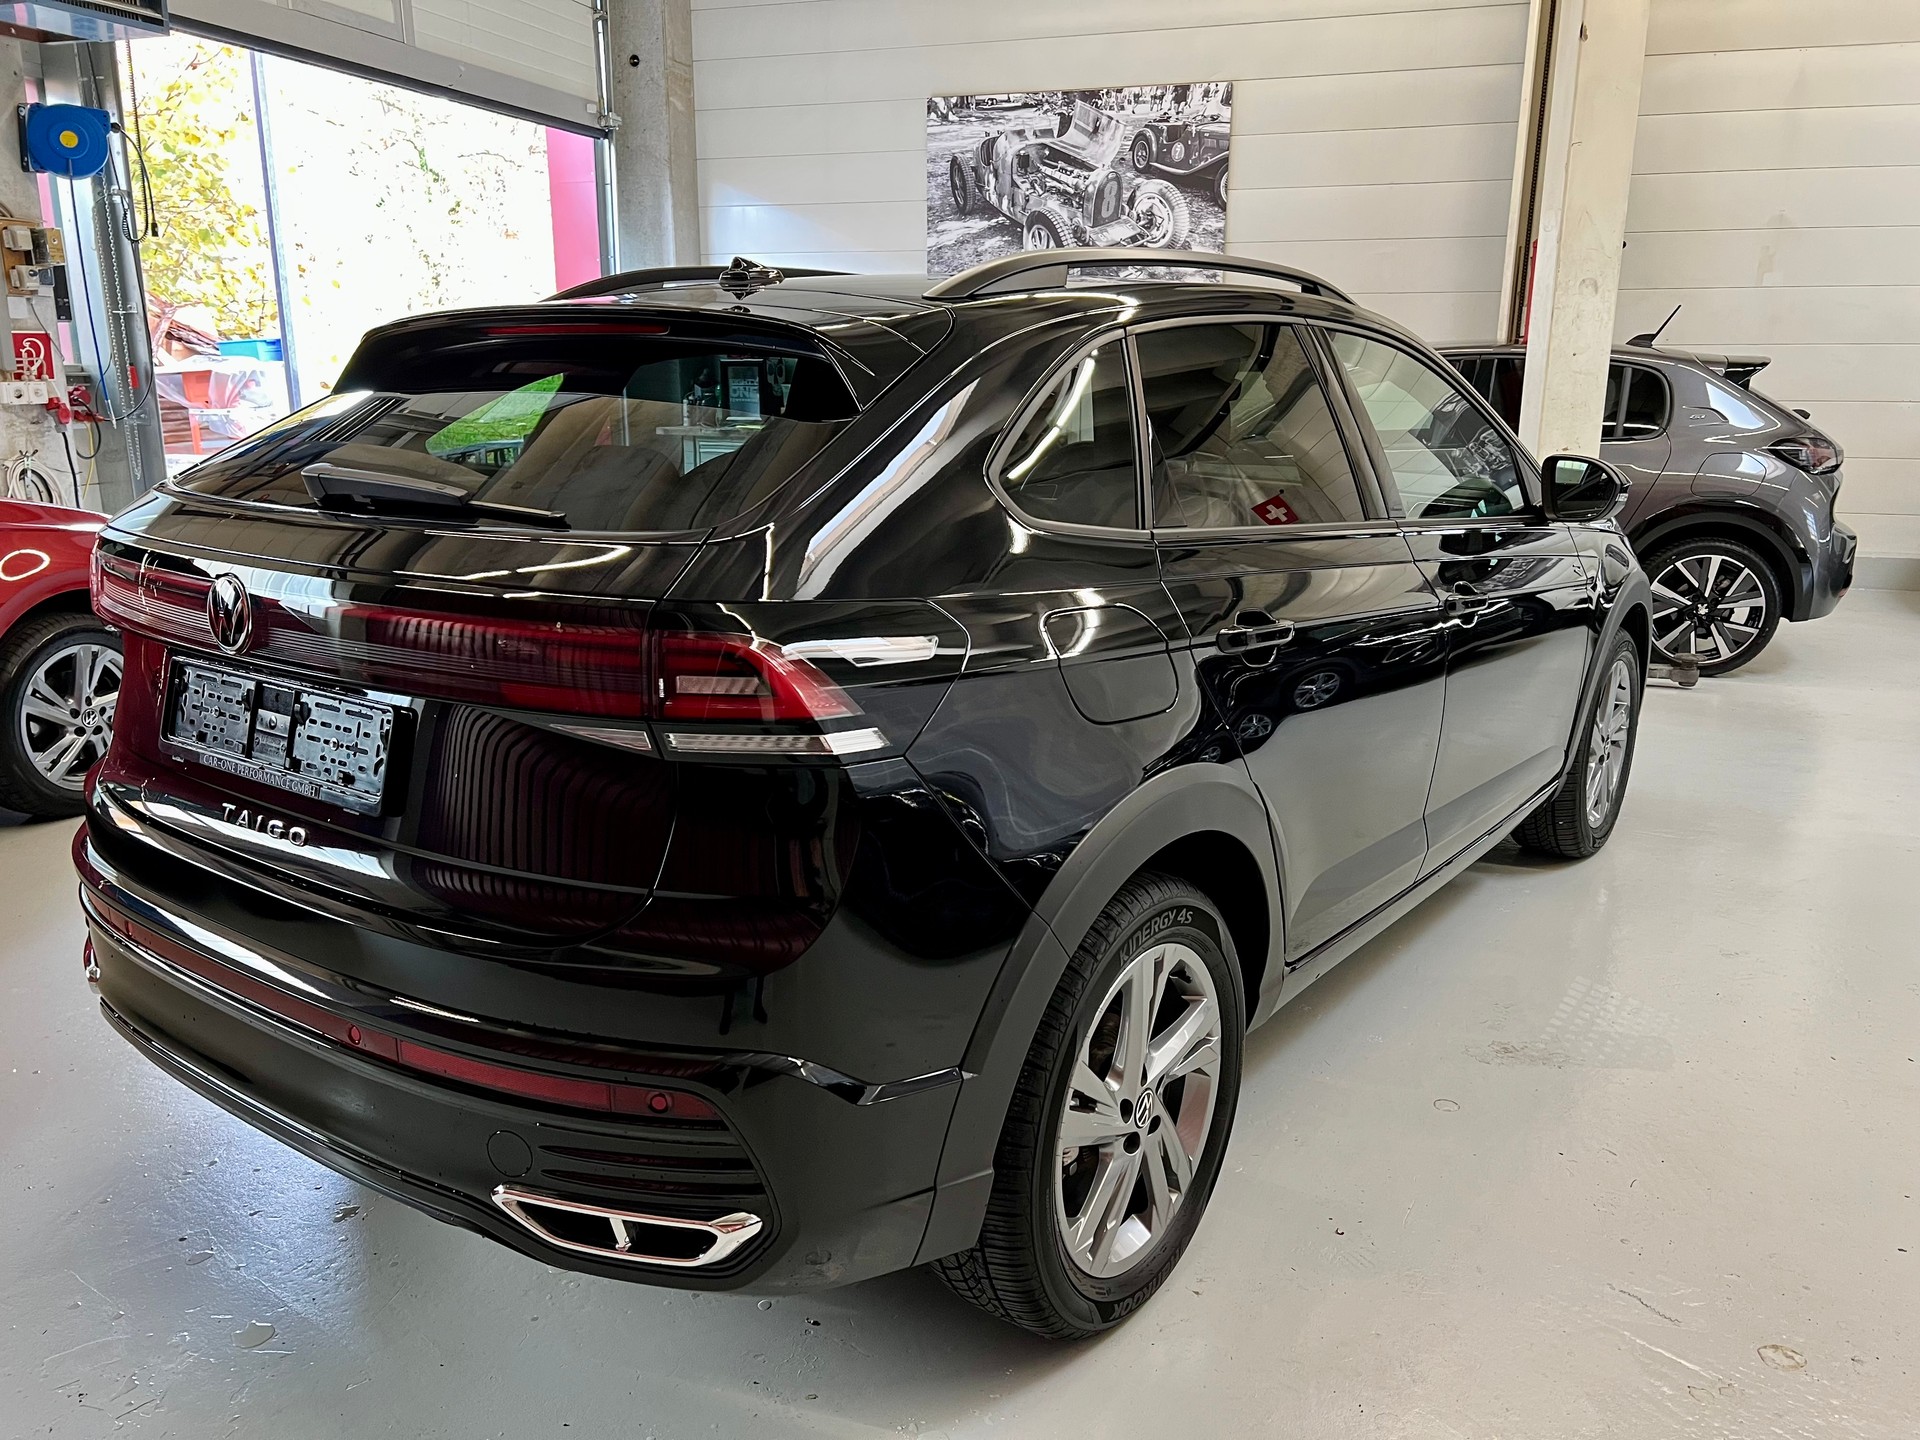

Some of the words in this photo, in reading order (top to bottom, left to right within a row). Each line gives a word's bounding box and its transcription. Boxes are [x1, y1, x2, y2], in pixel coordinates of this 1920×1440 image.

[1101, 180, 1119, 219] 8
[203, 754, 235, 773] CAR-ONE
[237, 764, 290, 789] PERFORMANCE
[291, 781, 316, 797] GMBH
[222, 802, 309, 847] TAIGO
[1120, 909, 1177, 967] KINERGY
